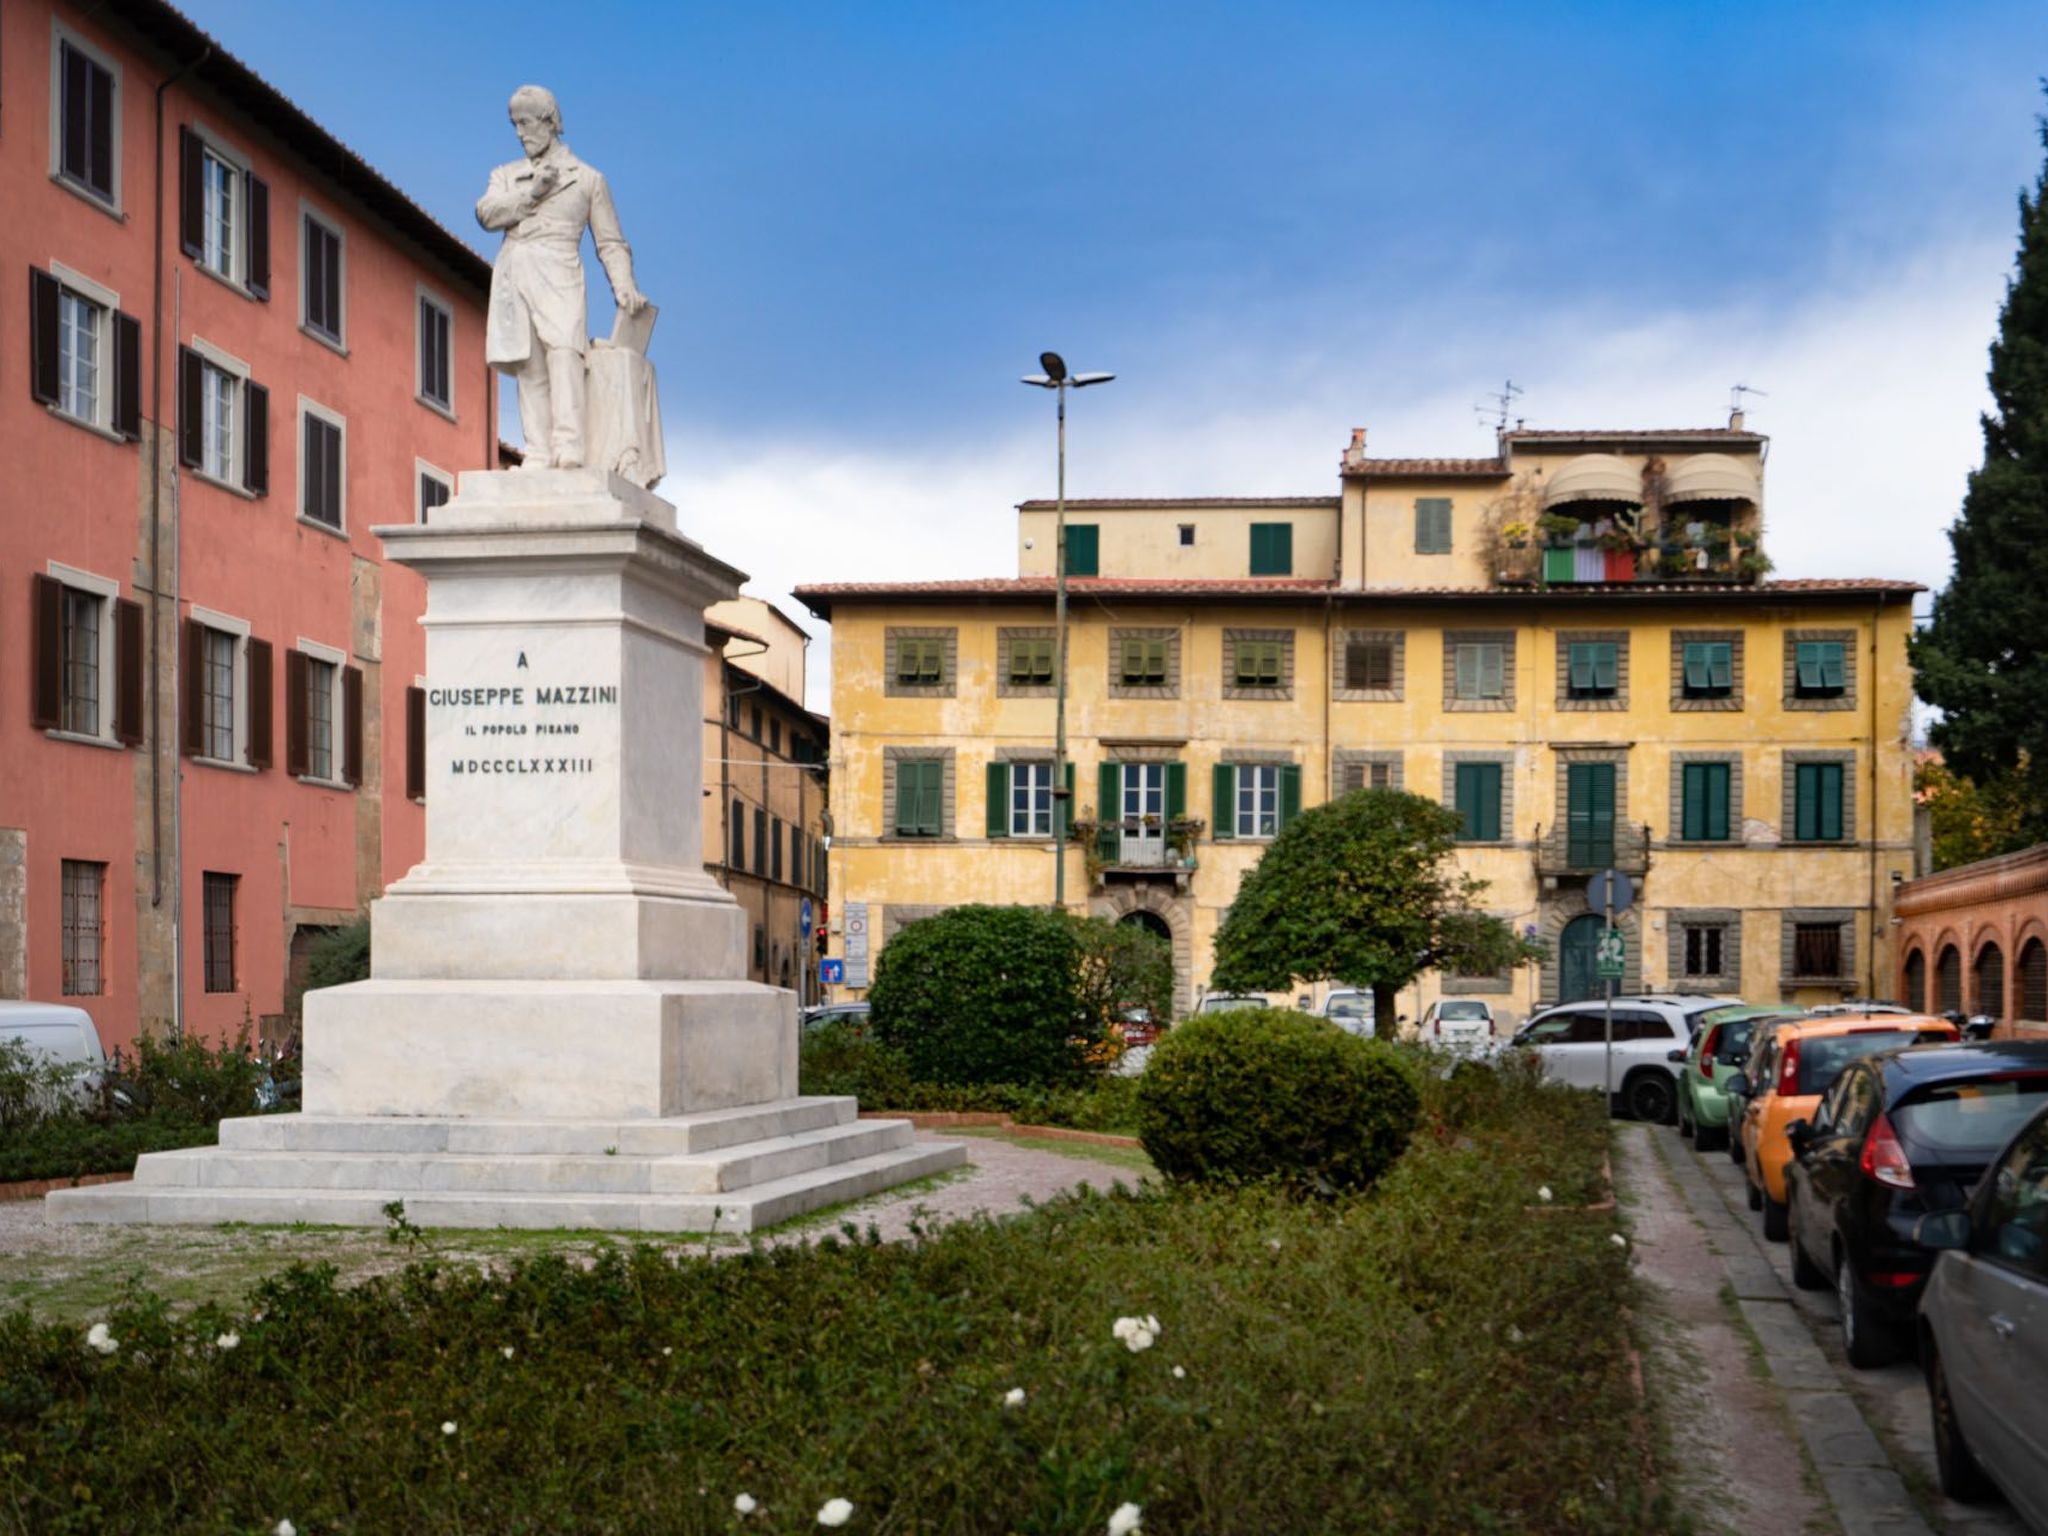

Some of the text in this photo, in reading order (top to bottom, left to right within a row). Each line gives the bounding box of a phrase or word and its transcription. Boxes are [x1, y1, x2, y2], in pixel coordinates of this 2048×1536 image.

[516, 651, 529, 669] A
[429, 685, 617, 707] GIUSEPPE MAZZINI
[465, 723, 580, 736] IL POPOLO PISANO
[451, 758, 592, 774] MDCCCLXXXIII
